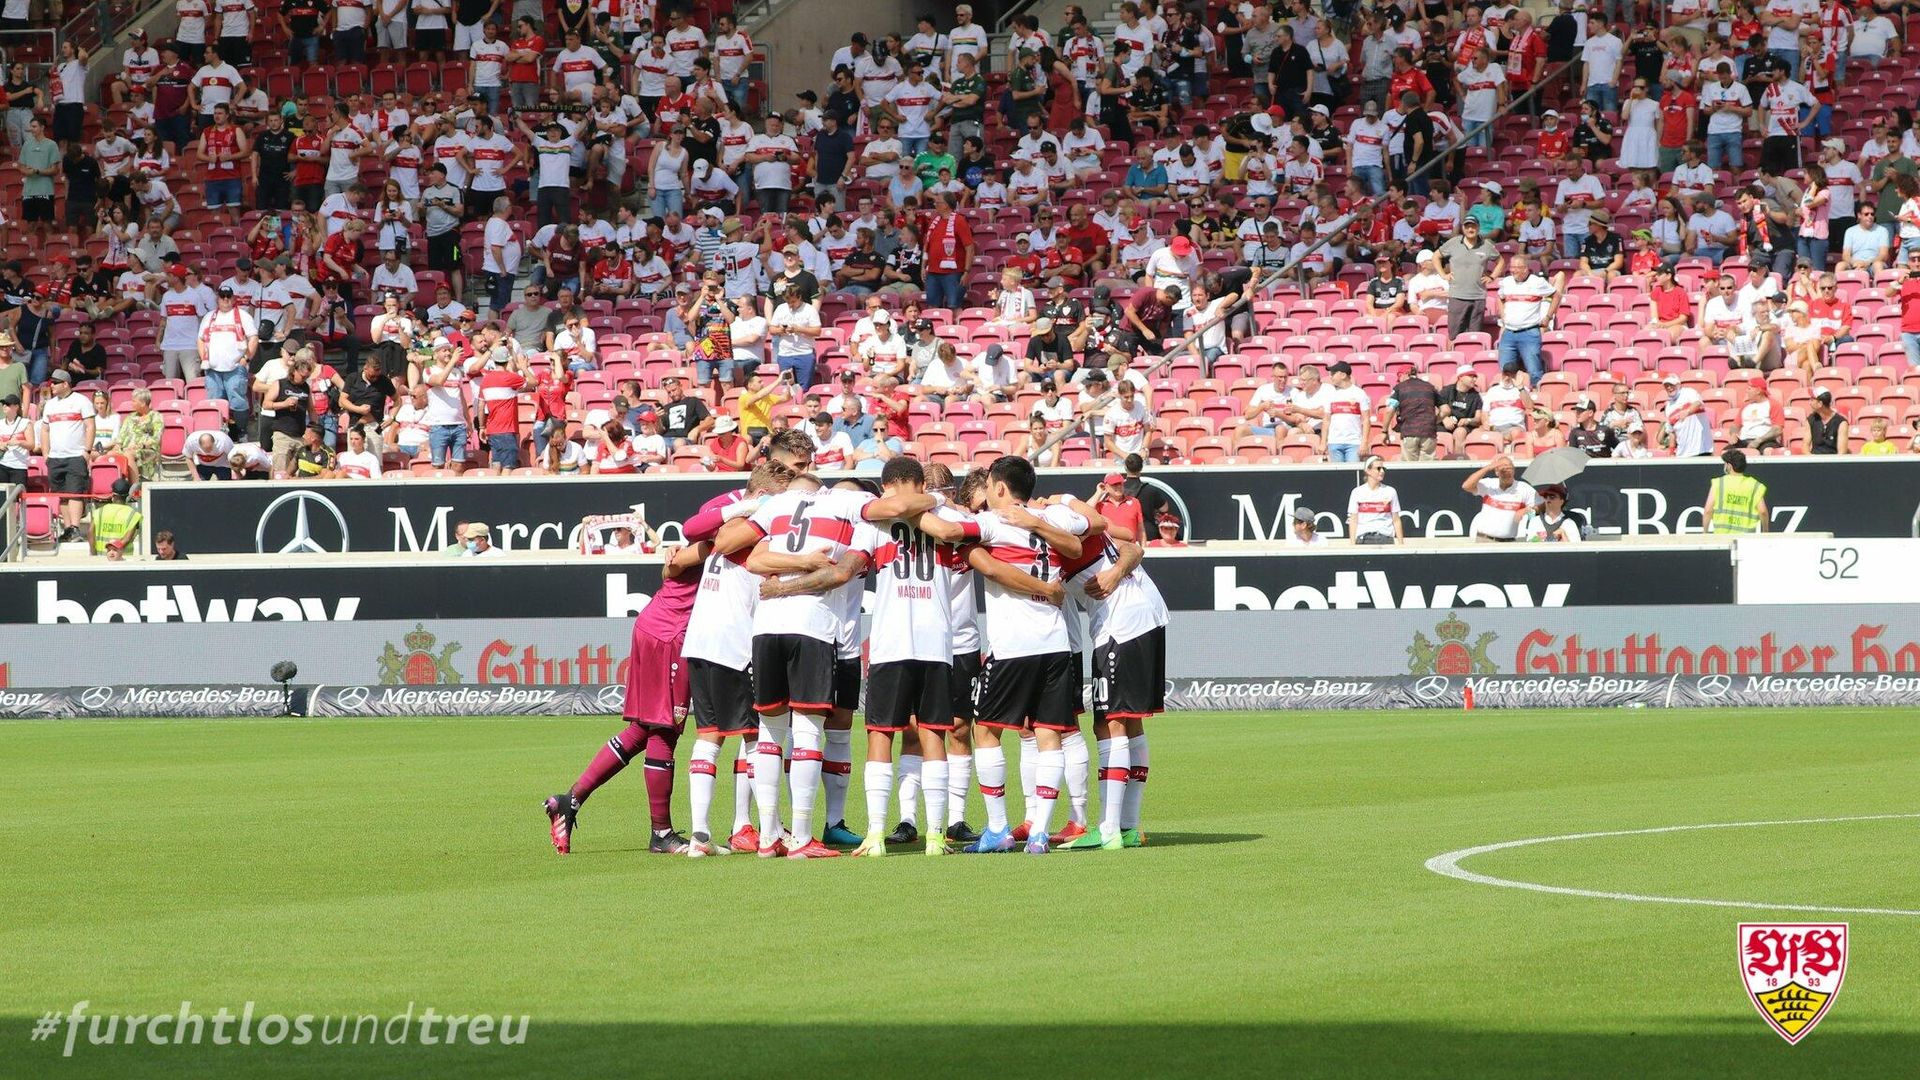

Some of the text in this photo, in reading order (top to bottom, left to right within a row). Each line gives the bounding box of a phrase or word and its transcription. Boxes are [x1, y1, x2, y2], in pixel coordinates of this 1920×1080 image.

[786, 500, 815, 553] 5
[890, 521, 935, 582] 30
[1818, 547, 1859, 580] 52
[897, 585, 932, 600] MASSIMO
[1031, 593, 1050, 602] END
[1186, 677, 1373, 699] Mercedes-Benz
[1461, 675, 1649, 694] Mercedes-Benz
[1744, 674, 1920, 693] Mercedes-Ben
[122, 686, 293, 704] Mercedes-Benz
[380, 686, 556, 705] Mercedes-Benz
